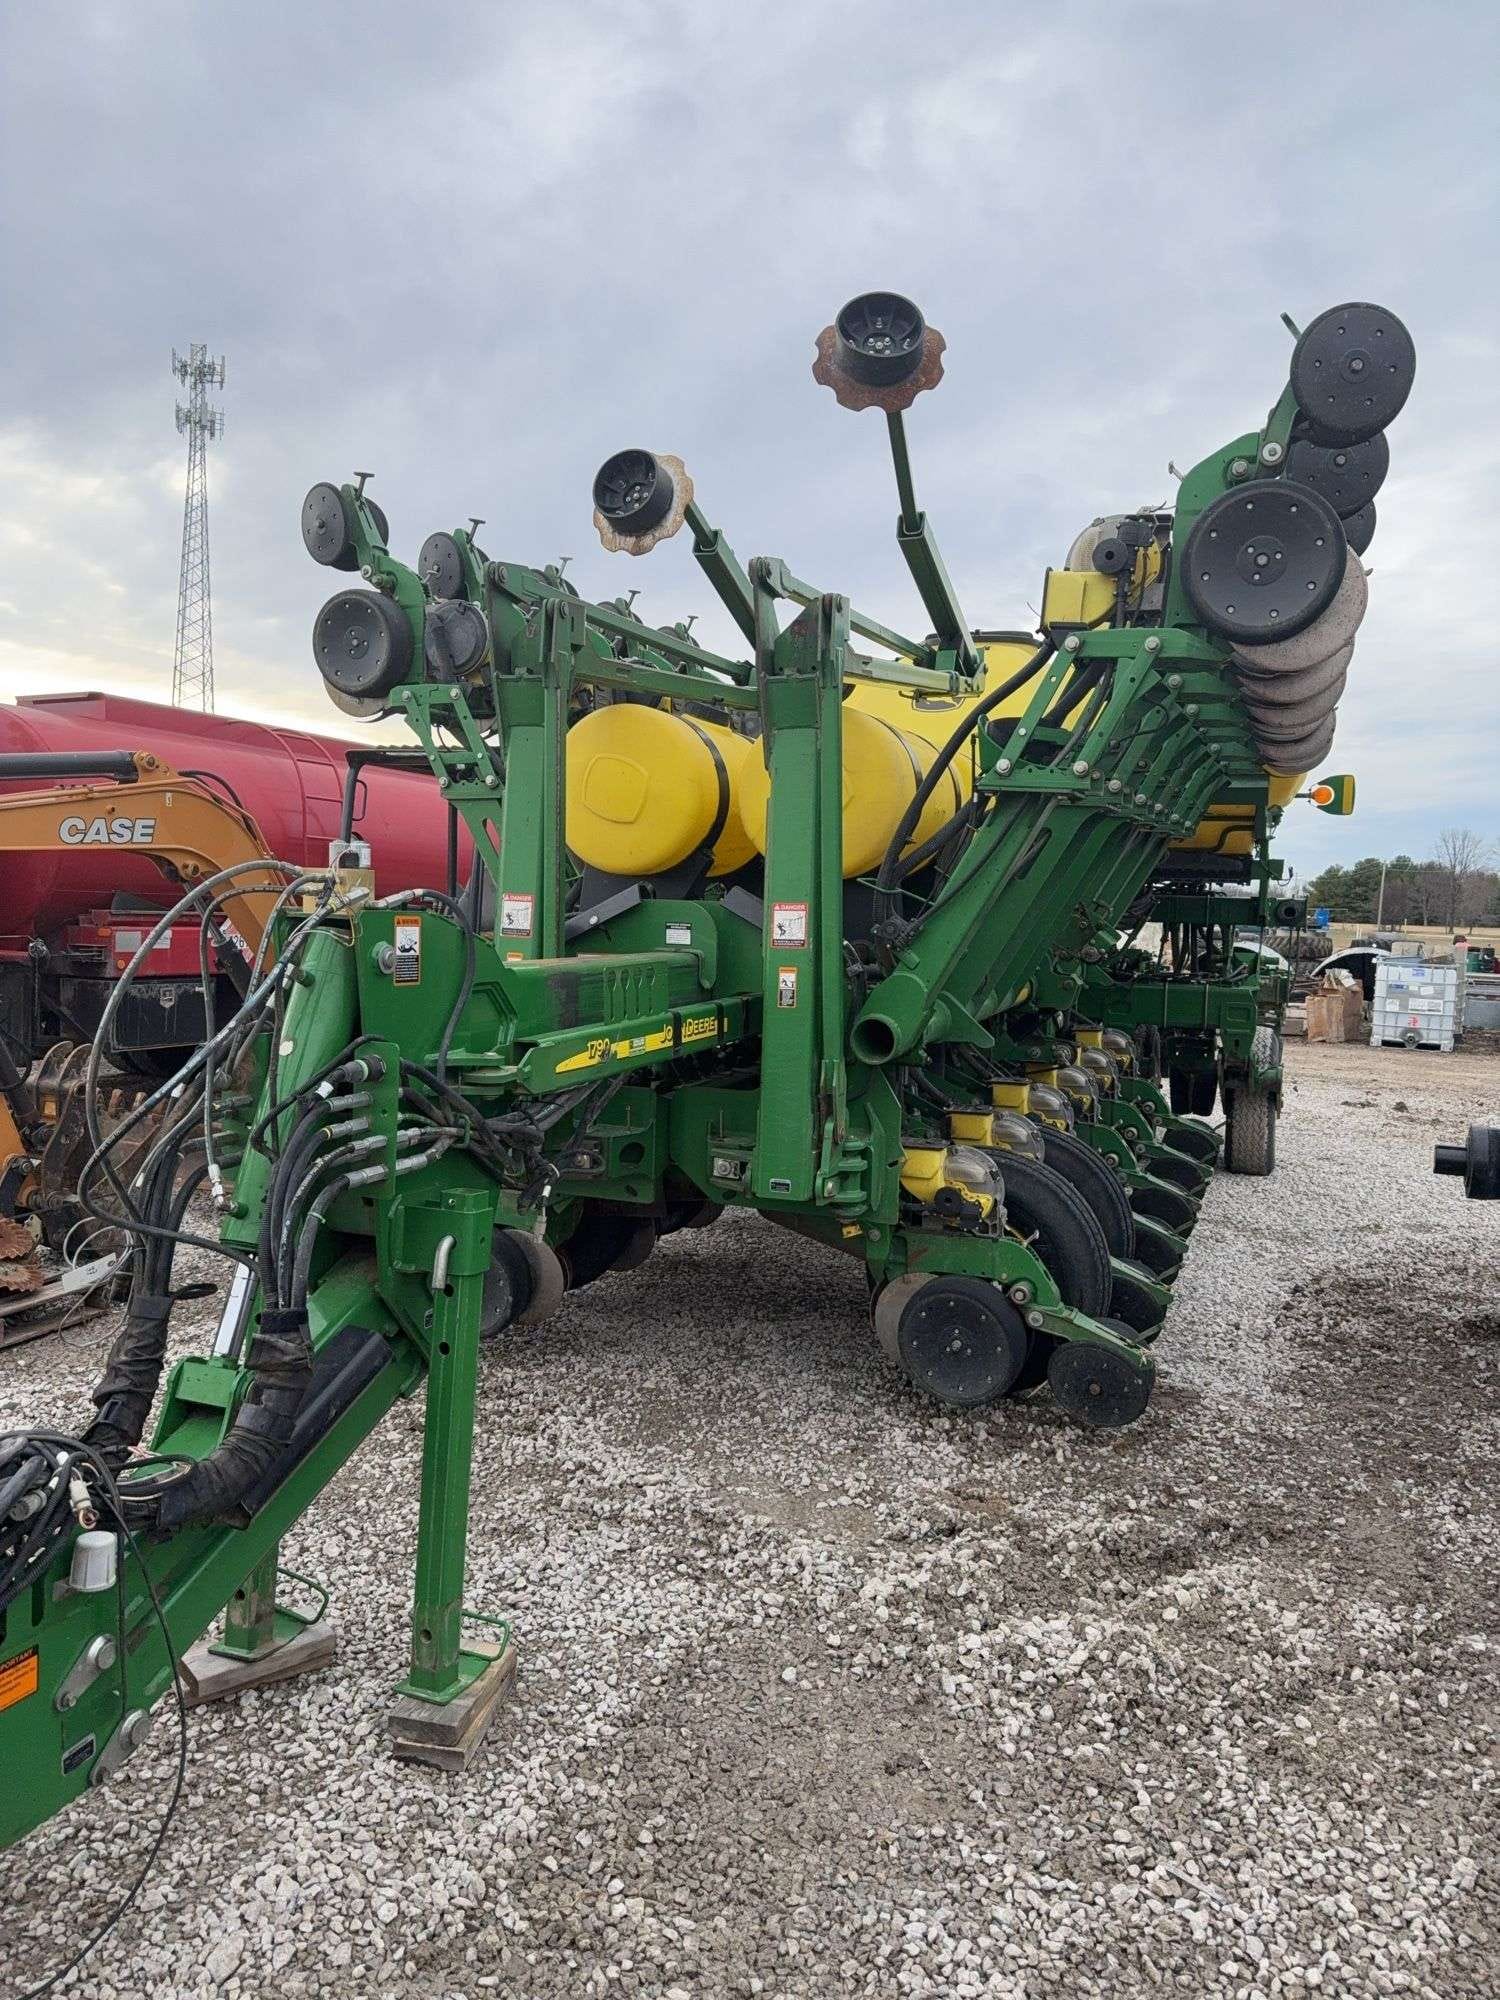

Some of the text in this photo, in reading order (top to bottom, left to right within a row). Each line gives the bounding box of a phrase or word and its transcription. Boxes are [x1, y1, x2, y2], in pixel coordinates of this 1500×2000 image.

[59, 816, 157, 844] CASE
[686, 1016, 715, 1036] DEERE
[587, 1038, 611, 1059] 1790
